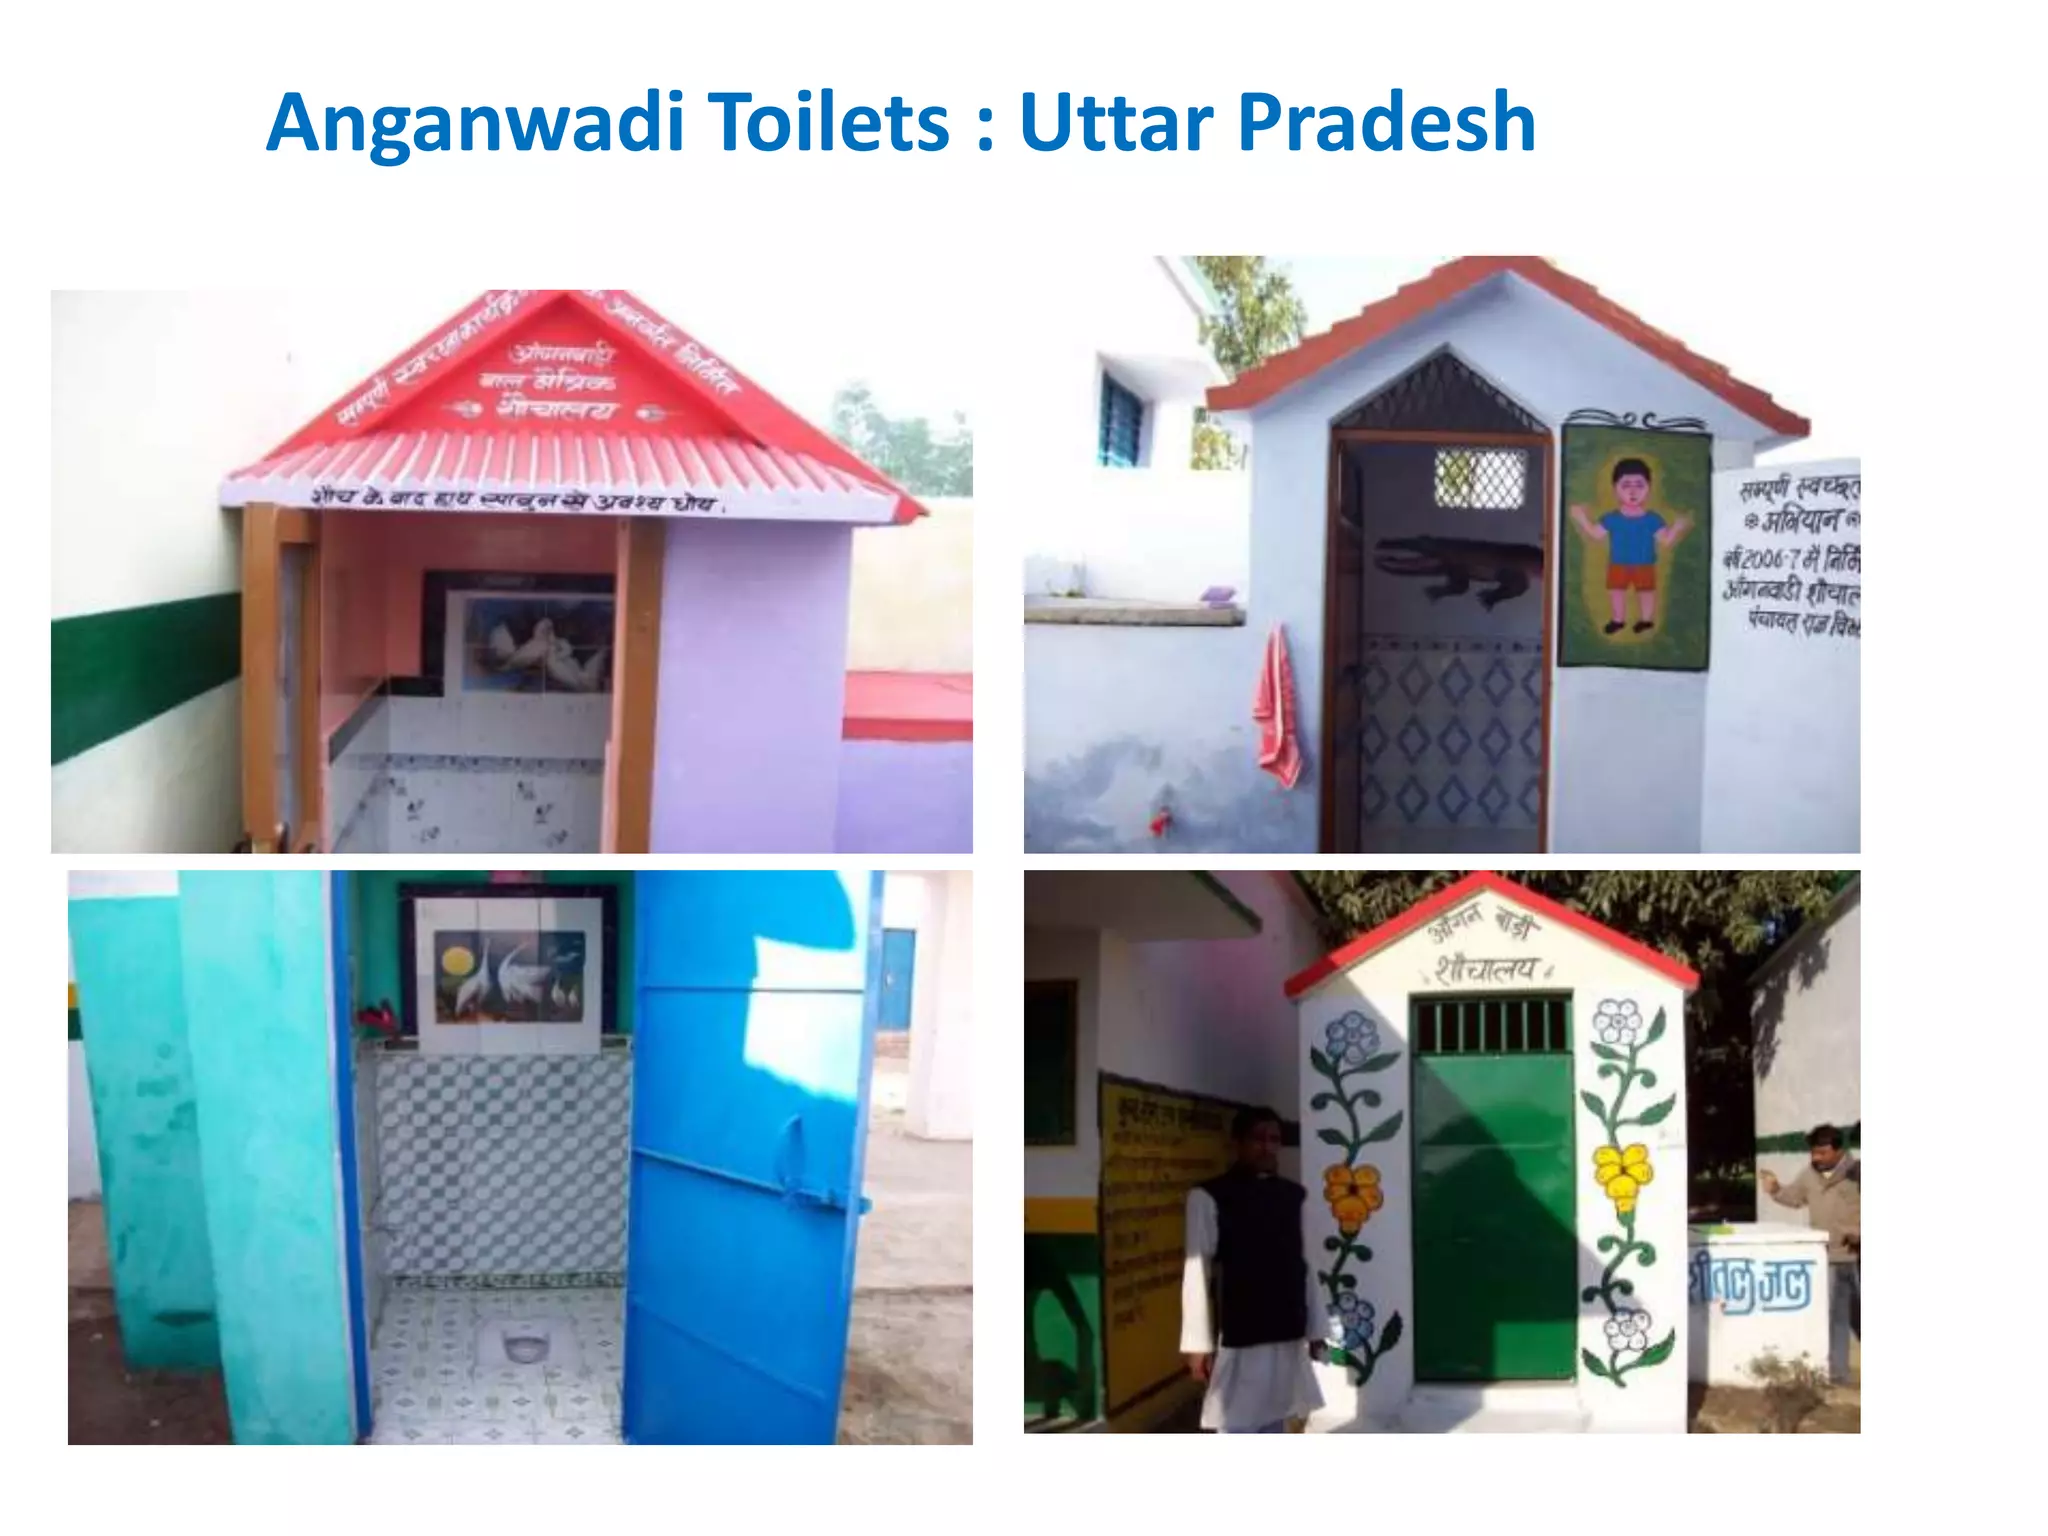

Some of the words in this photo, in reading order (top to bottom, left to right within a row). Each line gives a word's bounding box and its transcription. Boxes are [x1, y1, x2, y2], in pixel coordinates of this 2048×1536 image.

[1762, 501, 1846, 535] अभियान
[1435, 951, 1543, 987] शौचालय
[1758, 1258, 1818, 1313] जल
